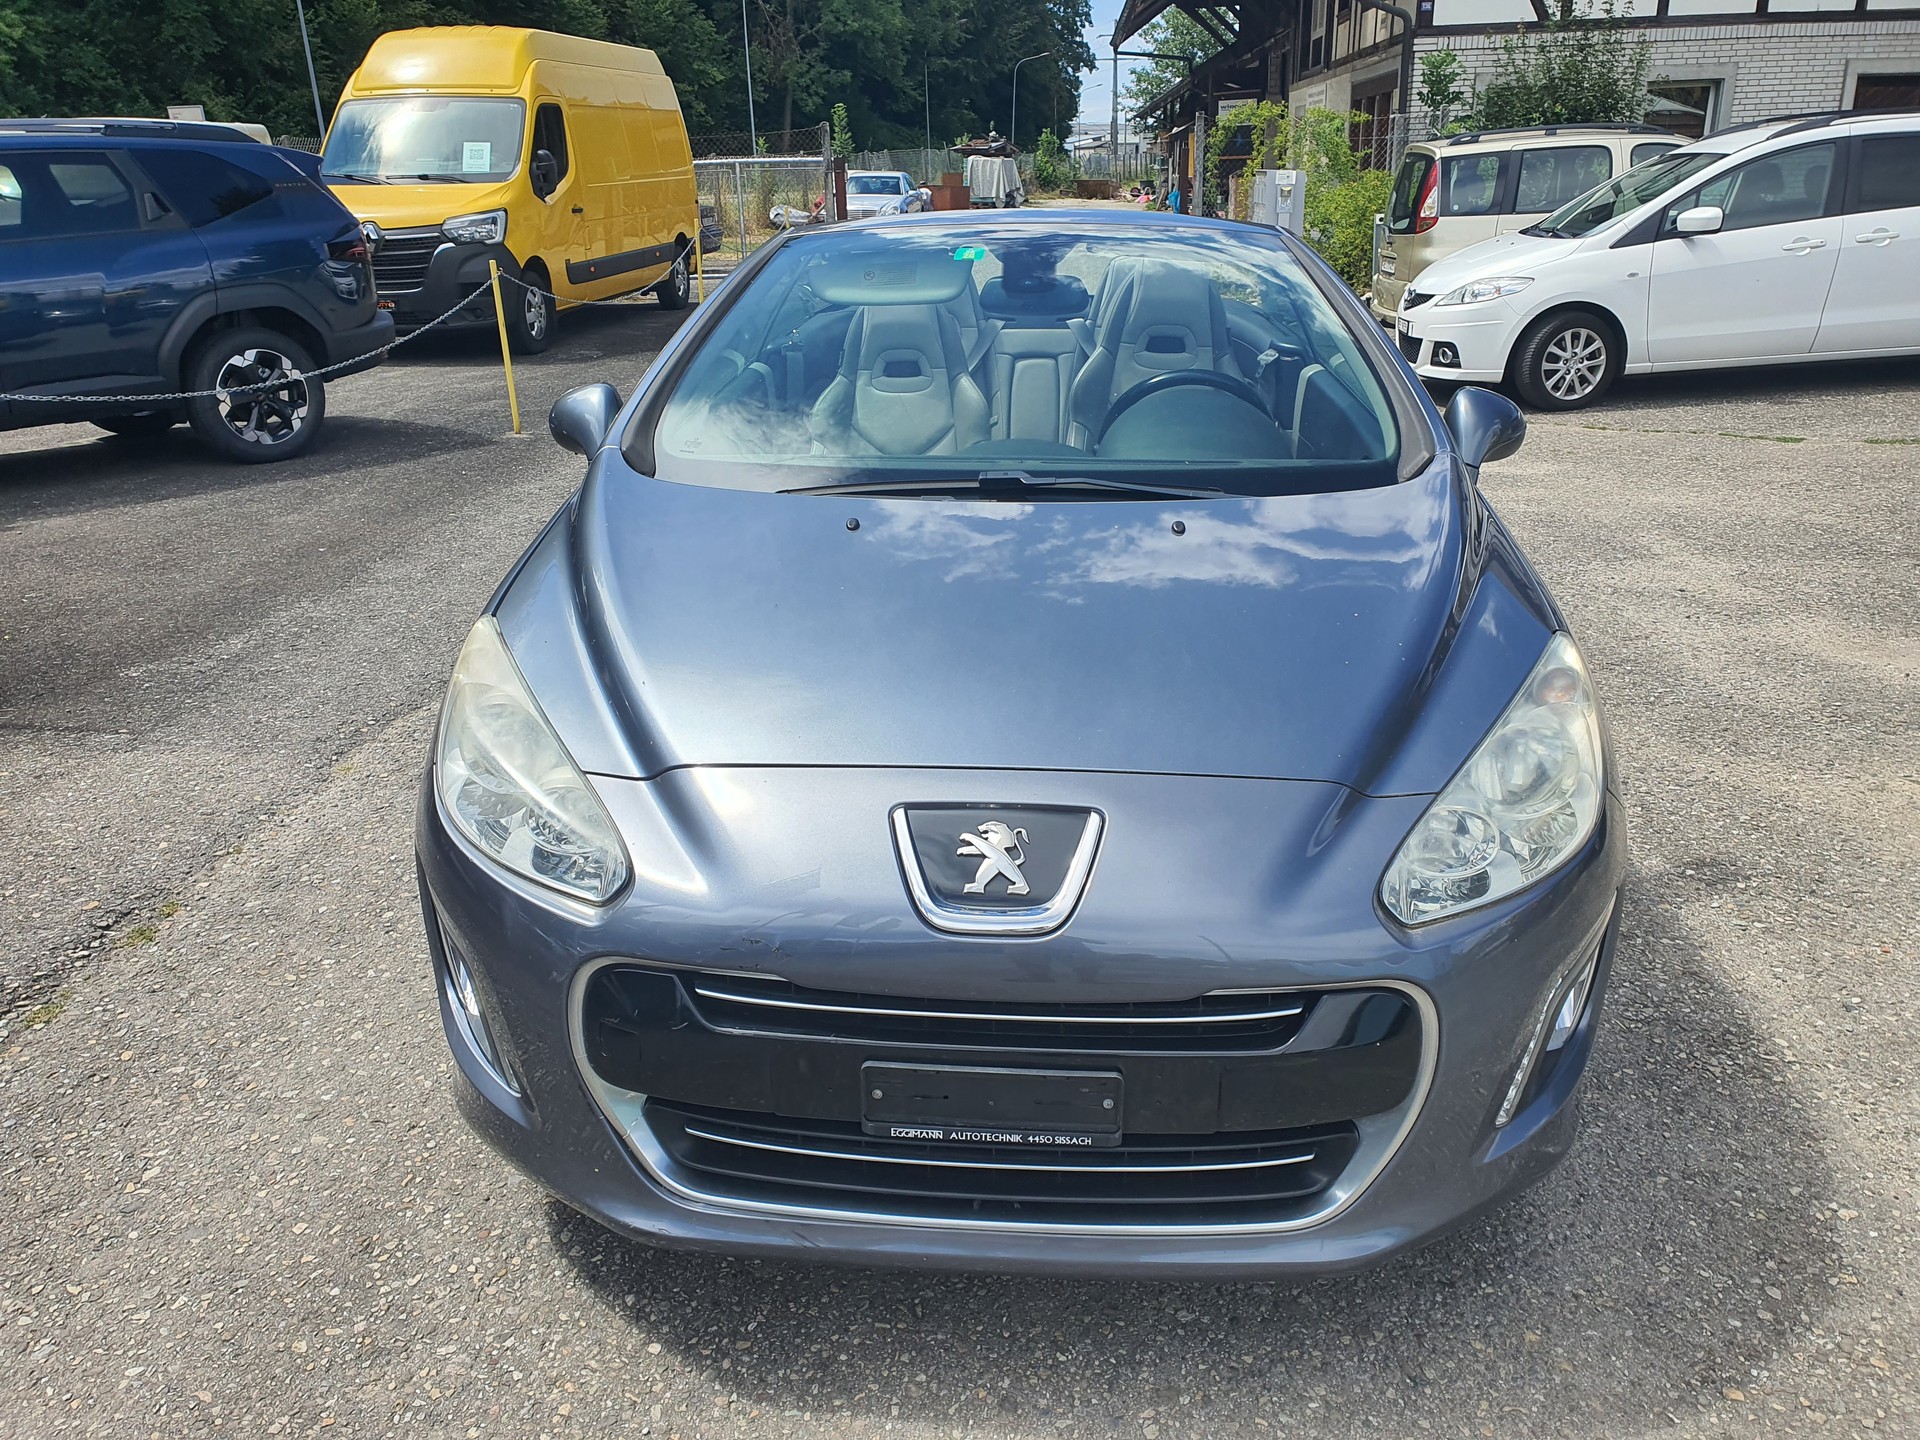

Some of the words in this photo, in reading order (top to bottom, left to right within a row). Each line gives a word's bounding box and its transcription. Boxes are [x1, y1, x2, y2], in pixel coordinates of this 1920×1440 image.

[890, 1127, 943, 1139] EGGIMANN
[949, 1131, 1023, 1143] AUTOTECHNIK
[1027, 1135, 1053, 1144] 4450
[1054, 1136, 1092, 1146] SISSACH
